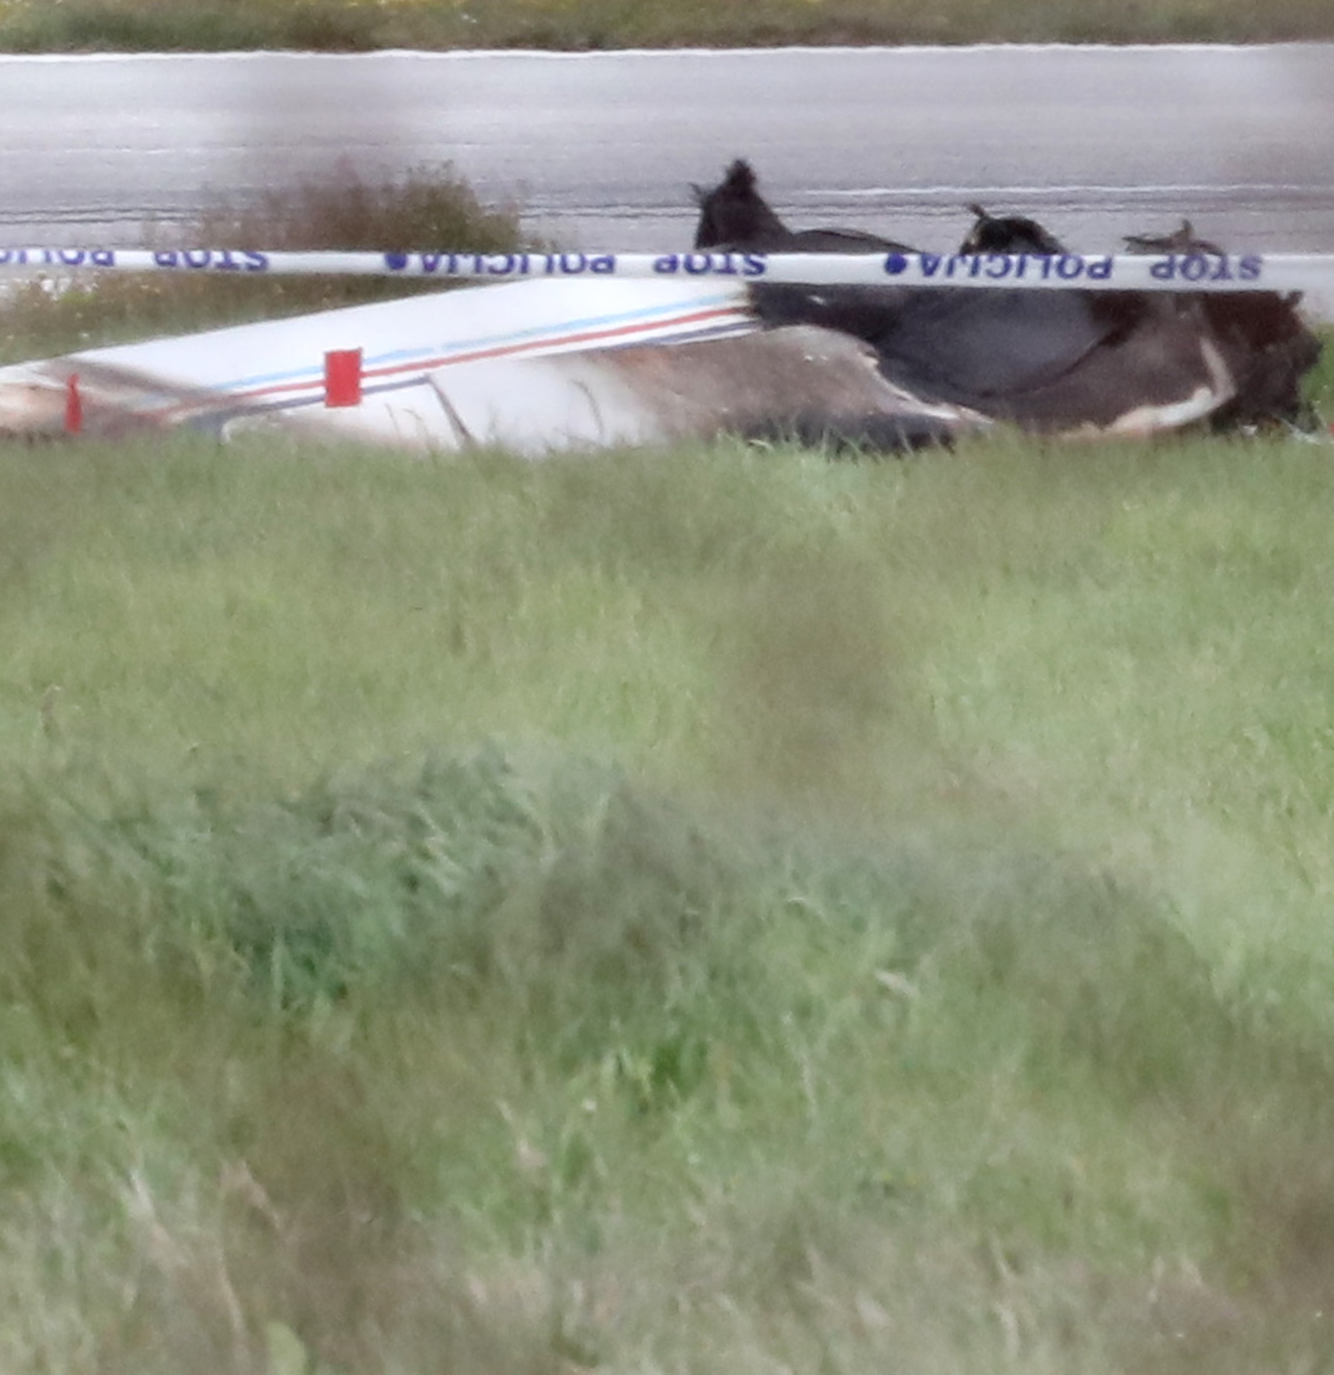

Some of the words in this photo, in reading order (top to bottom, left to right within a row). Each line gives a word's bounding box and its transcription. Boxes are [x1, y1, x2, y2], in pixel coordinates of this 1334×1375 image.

[653, 252, 766, 276] STOP
[919, 254, 1113, 280] POLICIJA
[1150, 254, 1263, 281] STOP
